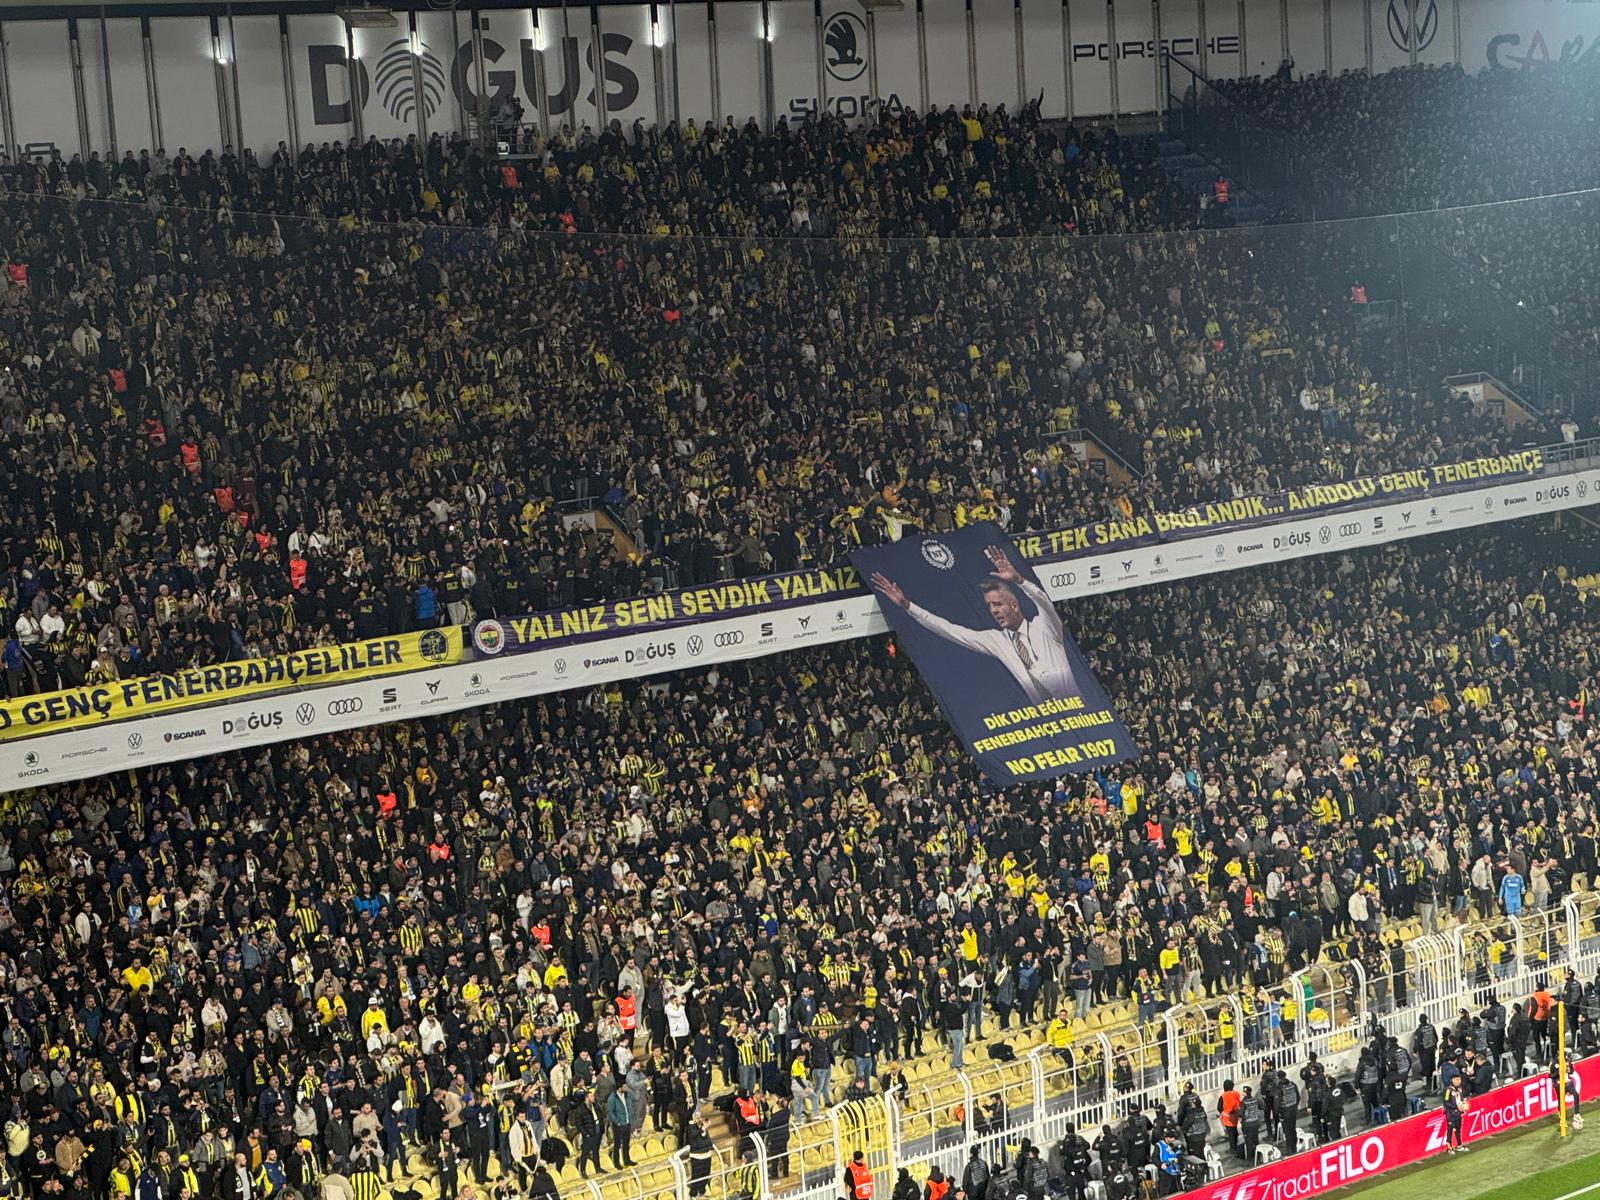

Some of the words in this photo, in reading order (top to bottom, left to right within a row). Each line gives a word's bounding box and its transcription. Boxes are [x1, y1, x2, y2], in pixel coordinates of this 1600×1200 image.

[1073, 37, 1239, 62] PORSCHE
[1047, 526, 1091, 554] TEK
[1094, 516, 1153, 544] SANA
[1288, 478, 1375, 511] ANADOLU
[1379, 468, 1429, 493] GENÇ
[1431, 449, 1544, 485] FENERBAHÇE
[508, 604, 609, 644] YALNIZ
[614, 592, 675, 628] SENİ
[680, 578, 768, 617] SEVDİK
[773, 566, 862, 601] YALNIZ
[831, 623, 853, 632] SKODA
[758, 637, 778, 645] SEAT
[592, 656, 619, 666] SCANIA
[22, 689, 112, 725] GENÇ
[121, 638, 403, 707] FENERBAHÇELİLER
[500, 671, 538, 681] PORSCHE
[464, 688, 490, 697] SKODA
[420, 696, 448, 705] CUPRA
[379, 704, 402, 712] SEAT
[983, 713, 1011, 730] DİK
[1008, 706, 1040, 724] DUR
[1037, 697, 1085, 716] EĞİLME
[173, 728, 206, 741] SCANIA
[972, 720, 1062, 754] FENERBAHÇE
[1059, 709, 1115, 732] SENİNLE!
[61, 747, 107, 759] PORSCHE
[1005, 757, 1036, 776] NO
[1033, 746, 1083, 770] FEAR
[1078, 739, 1117, 759] 1907
[18, 767, 49, 778] SKODA
